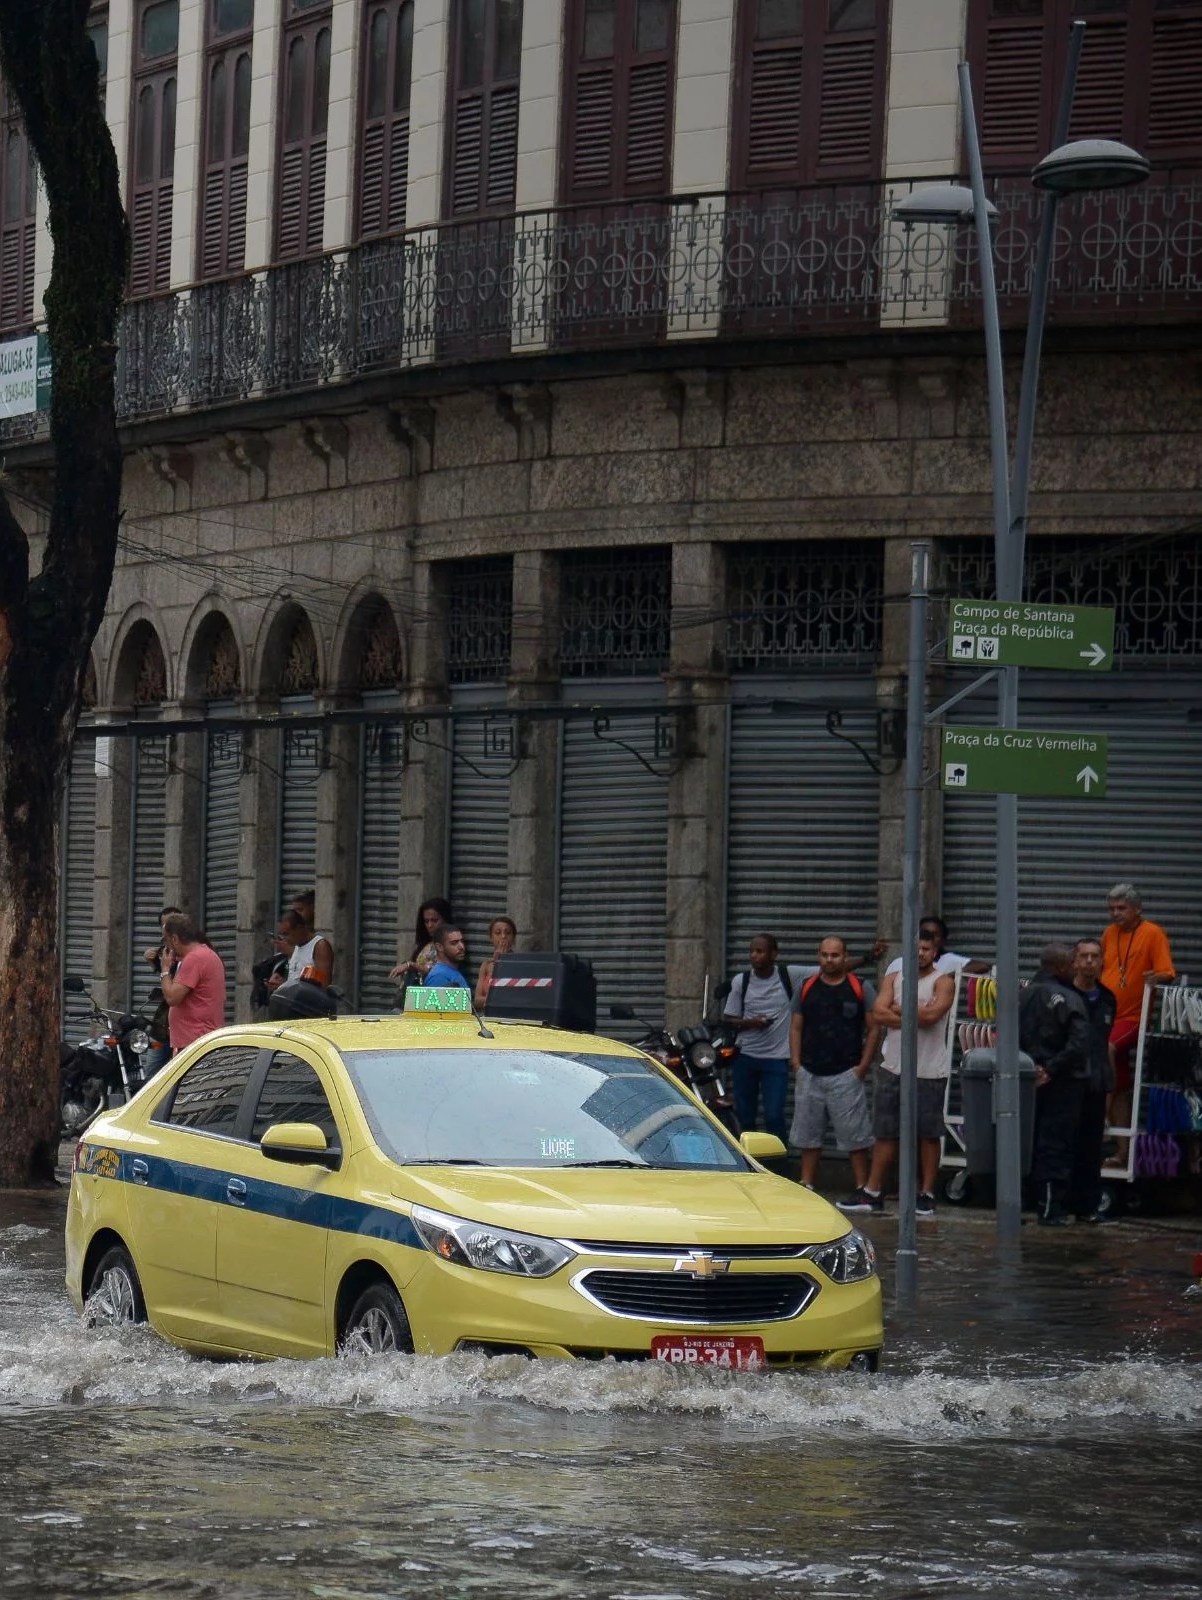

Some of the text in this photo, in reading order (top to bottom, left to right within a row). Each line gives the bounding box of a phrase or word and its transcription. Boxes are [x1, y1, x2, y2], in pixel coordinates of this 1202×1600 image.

[0, 347, 33, 376] ALUGA-SE
[953, 604, 1075, 623] Campo de Santana
[953, 620, 1074, 641] Praça da República
[945, 731, 1097, 752] Praça da Cruz Vermelha
[409, 989, 467, 1011] TAXI
[540, 1138, 575, 1158] LIVRE
